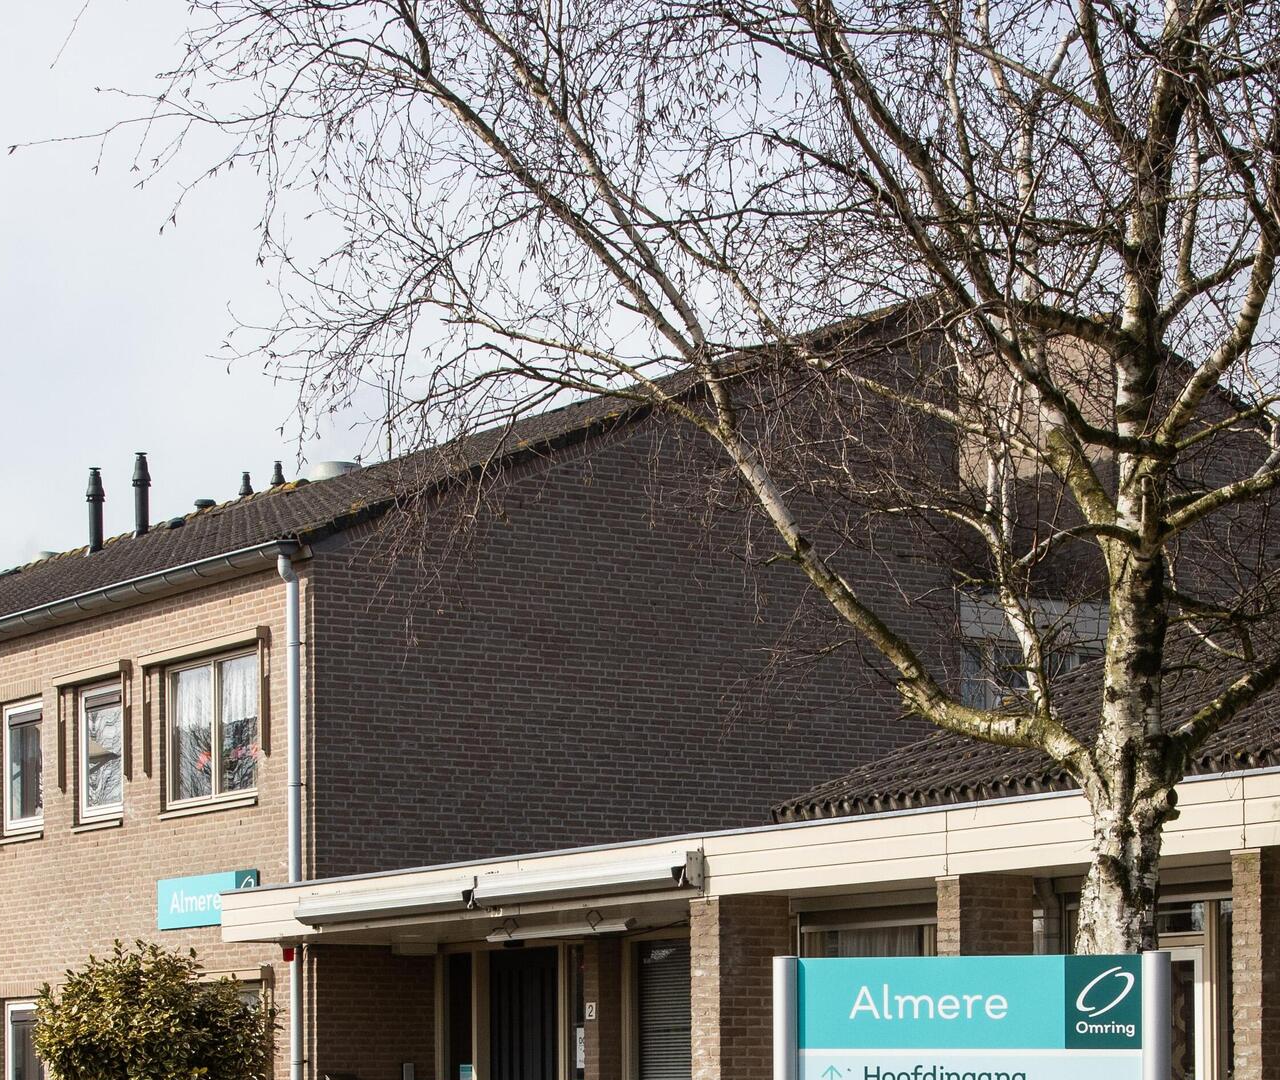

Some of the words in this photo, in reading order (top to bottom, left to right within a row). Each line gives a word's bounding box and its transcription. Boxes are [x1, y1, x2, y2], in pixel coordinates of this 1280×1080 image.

[170, 890, 221, 914] Almere
[588, 1004, 594, 1017] 2
[849, 983, 1009, 1020] Almere
[1075, 1020, 1135, 1038] Omring
